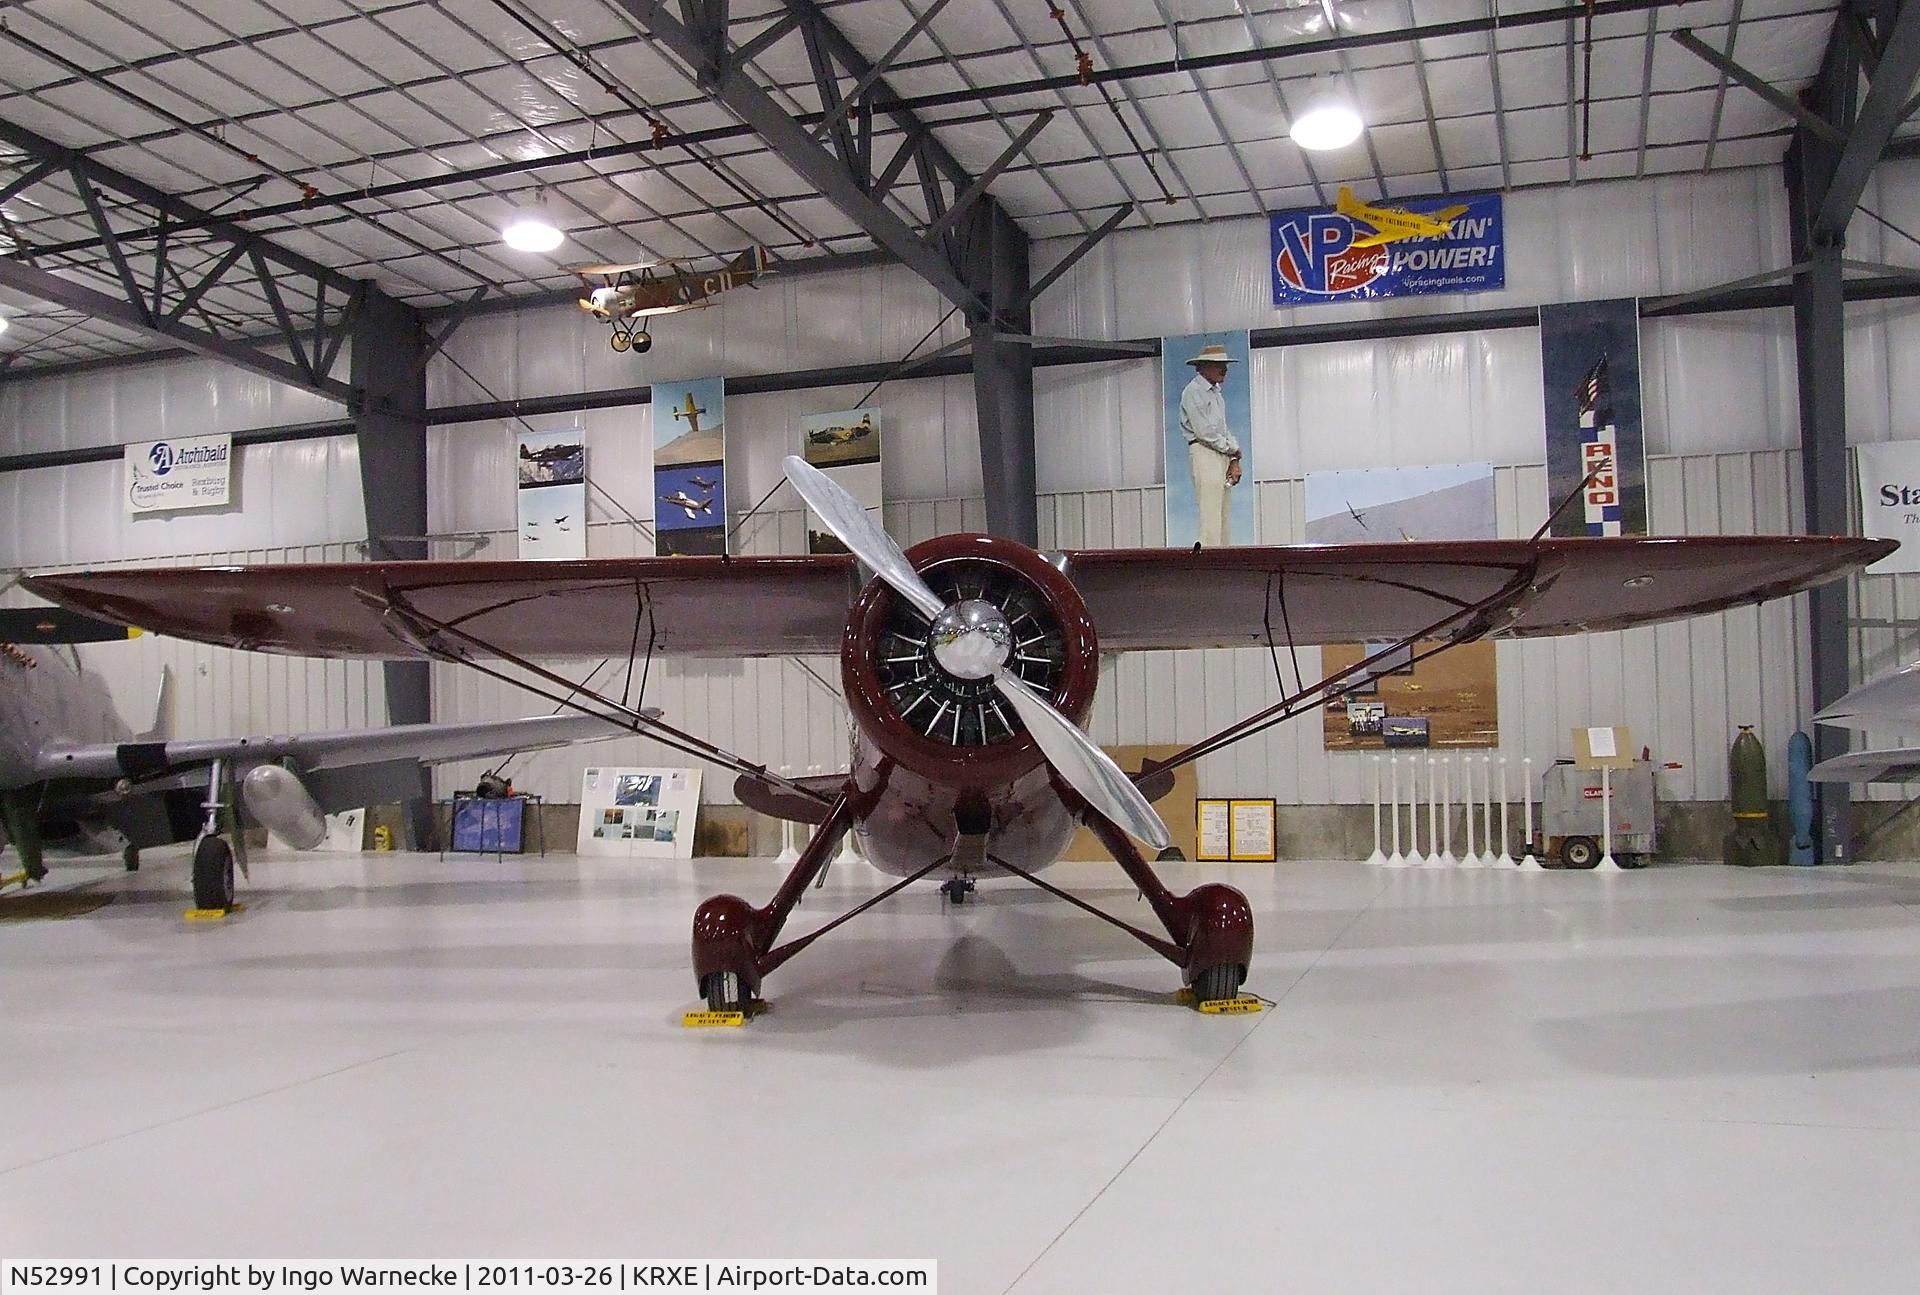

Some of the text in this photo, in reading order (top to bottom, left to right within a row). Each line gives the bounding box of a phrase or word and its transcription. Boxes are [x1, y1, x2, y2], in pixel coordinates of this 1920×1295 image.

[1278, 214, 1355, 293] VP
[1392, 246, 1496, 272] POWER!
[1330, 253, 1390, 284] Racing
[1403, 275, 1485, 288] vpracingfuels.com
[175, 444, 227, 464] Archibald
[137, 481, 184, 492] Trusted Choice
[1586, 443, 1616, 506] RENO
